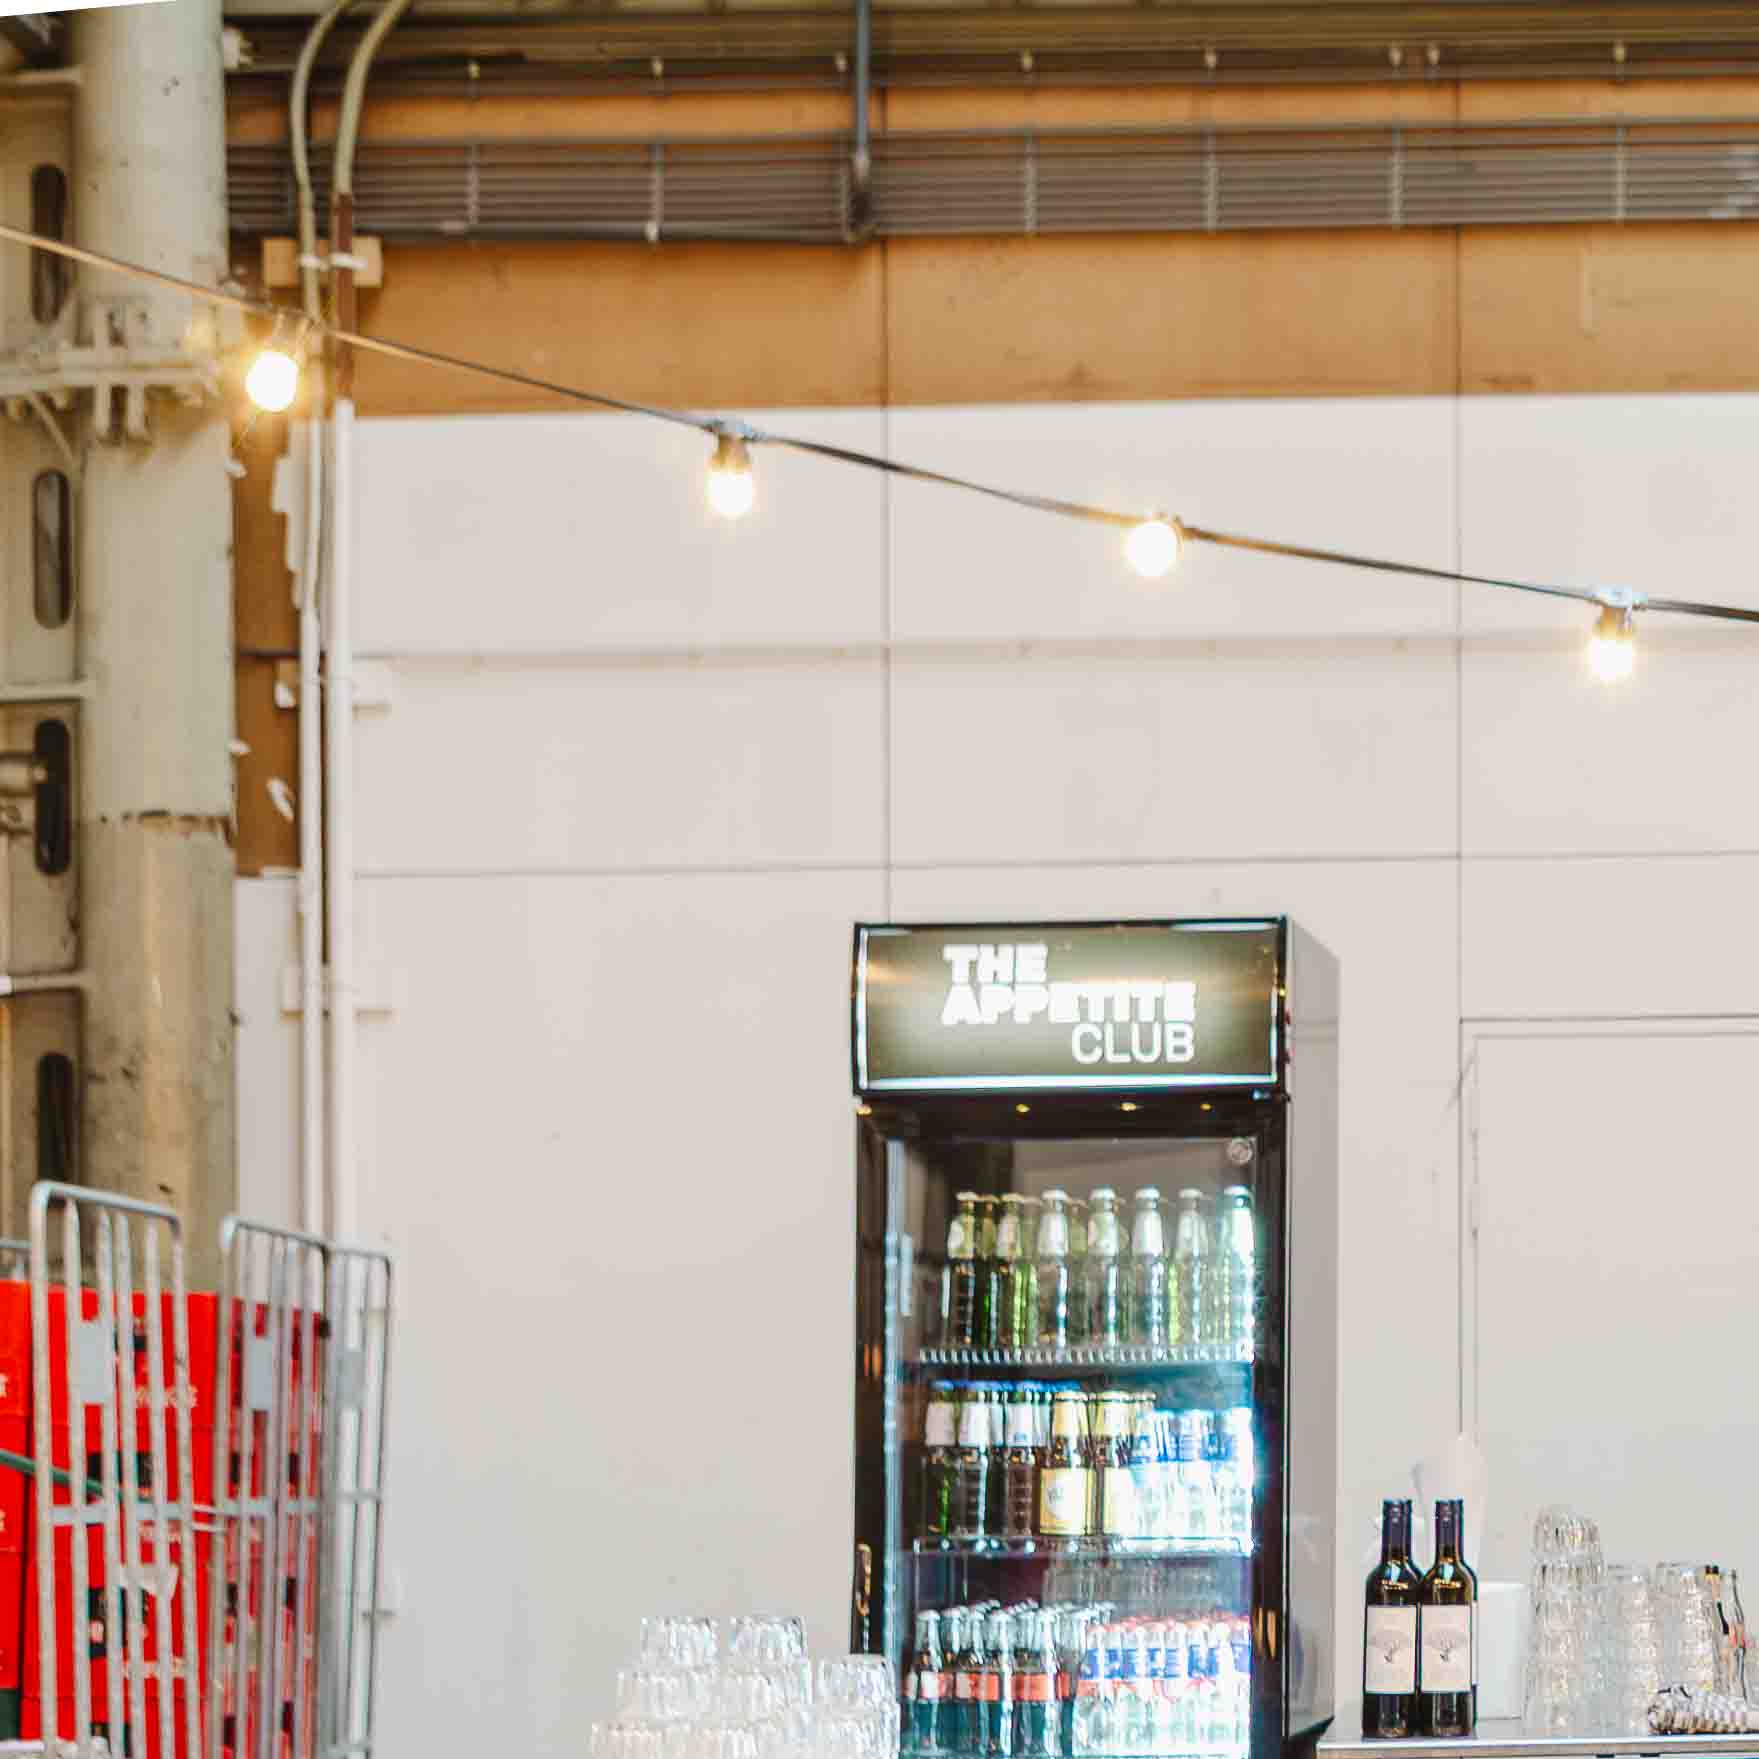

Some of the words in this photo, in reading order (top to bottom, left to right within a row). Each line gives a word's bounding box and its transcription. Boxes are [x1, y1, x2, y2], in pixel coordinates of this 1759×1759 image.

[943, 944, 1048, 983] THE
[941, 982, 1196, 1025] APPETITE
[1071, 1023, 1194, 1063] CLUB
